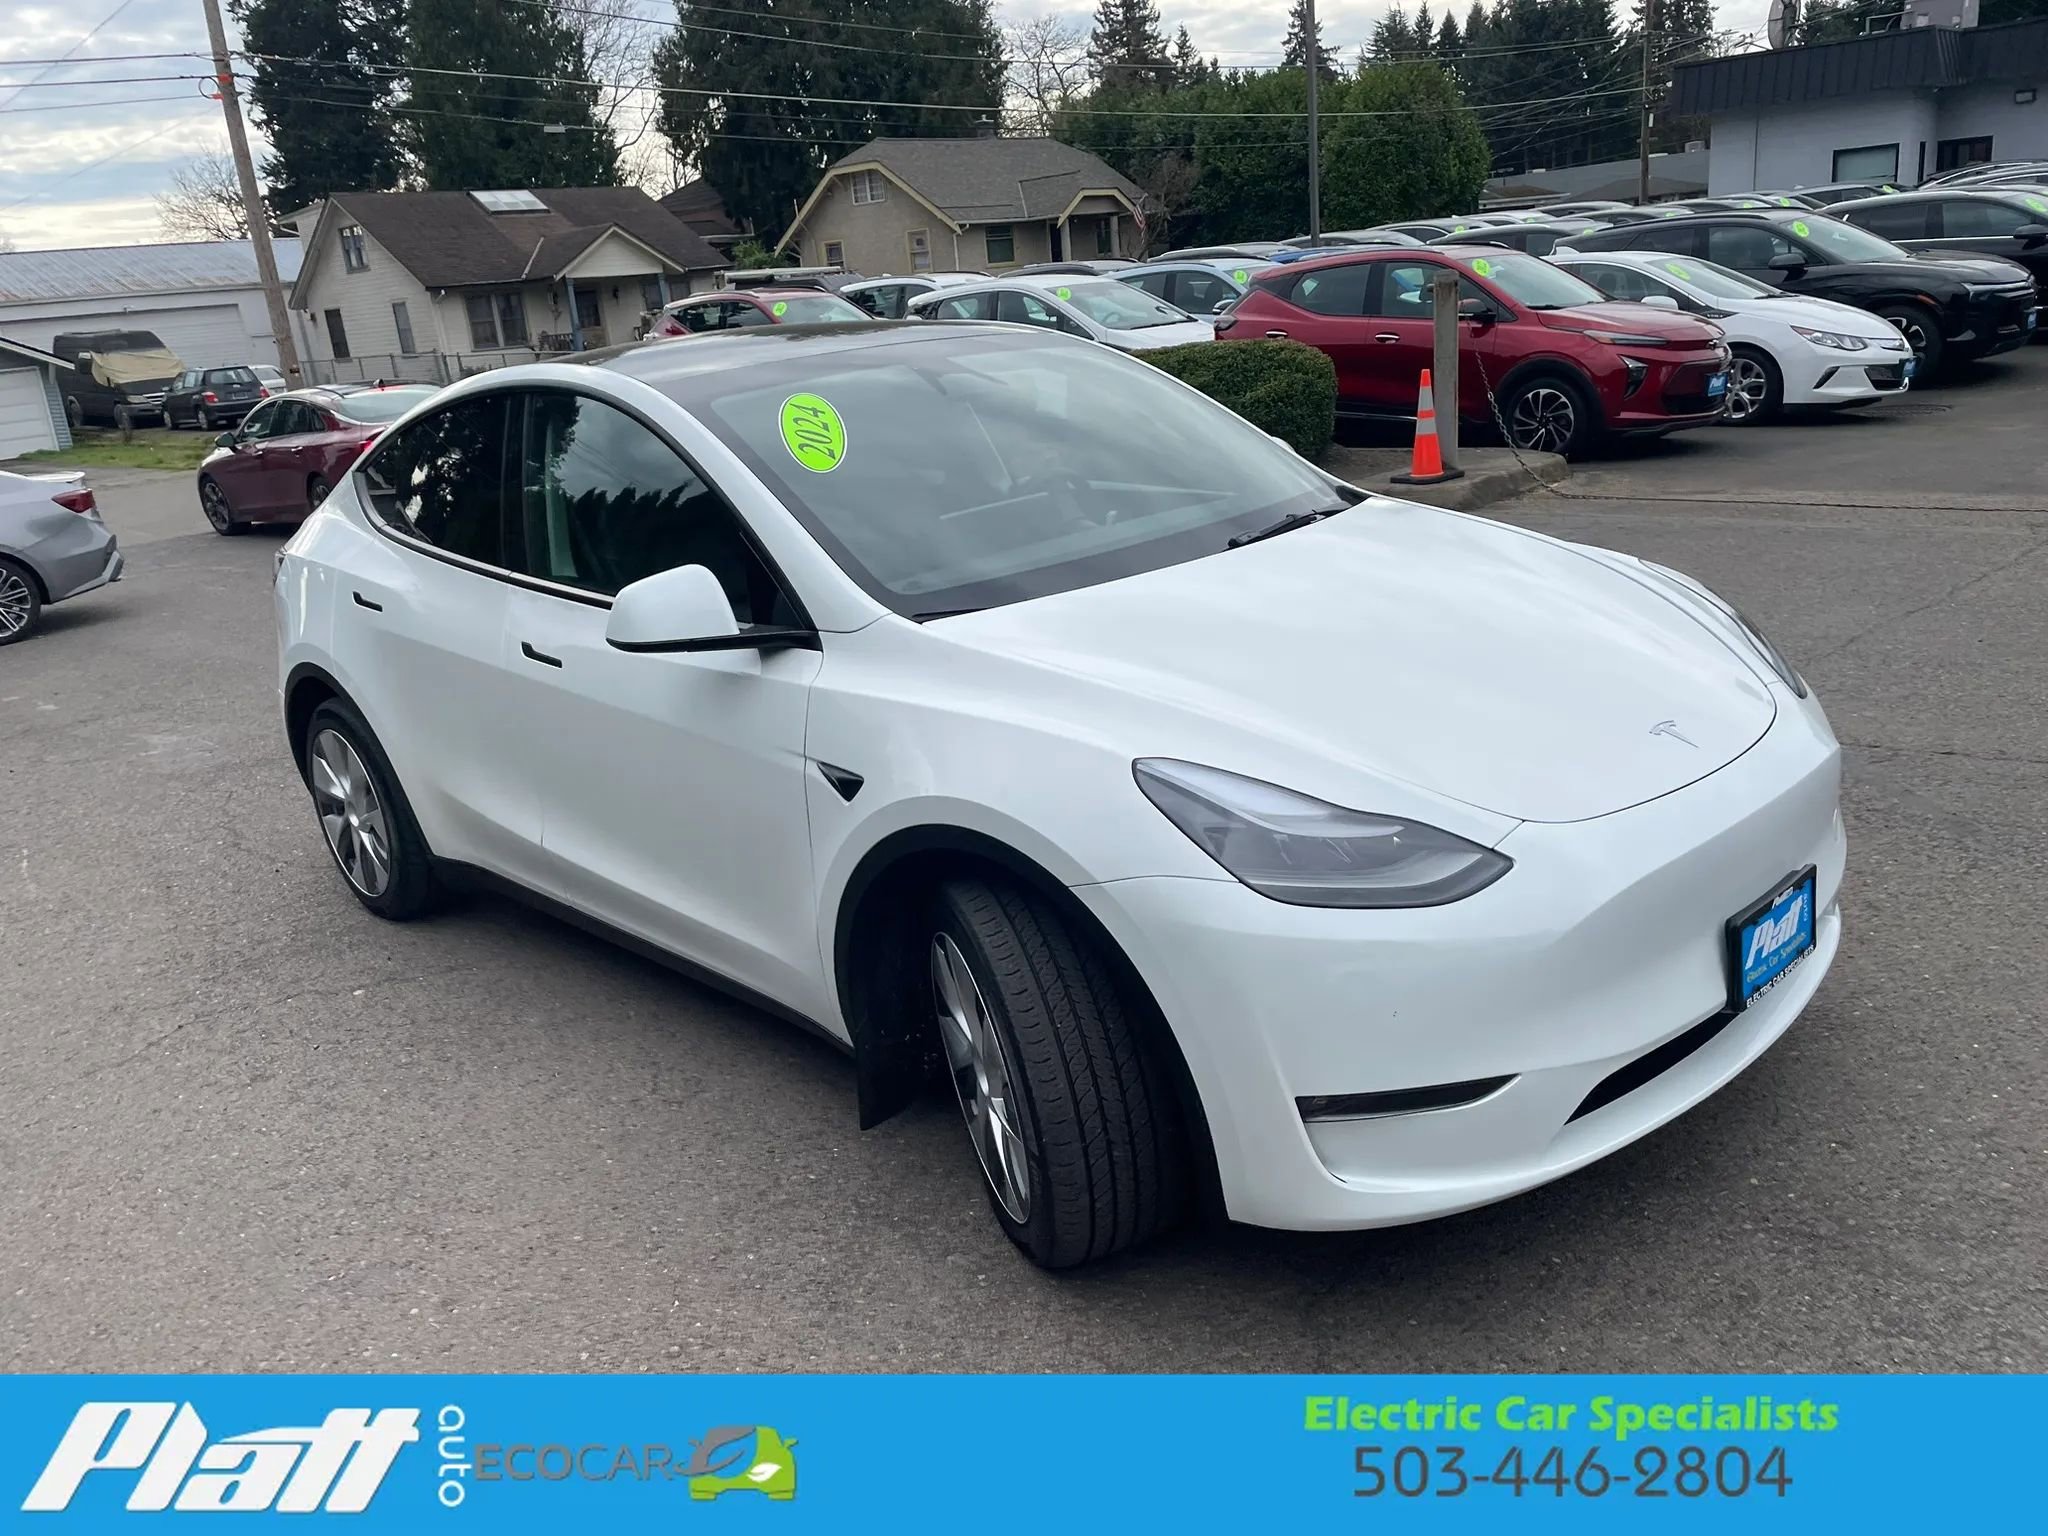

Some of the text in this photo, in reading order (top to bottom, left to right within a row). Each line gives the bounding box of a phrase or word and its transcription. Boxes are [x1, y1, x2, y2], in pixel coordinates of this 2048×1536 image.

[788, 402, 837, 461] 2024
[1744, 894, 1803, 970] Platt
[1745, 980, 1774, 1009] ELECTRIC
[1772, 970, 1785, 987] CAR
